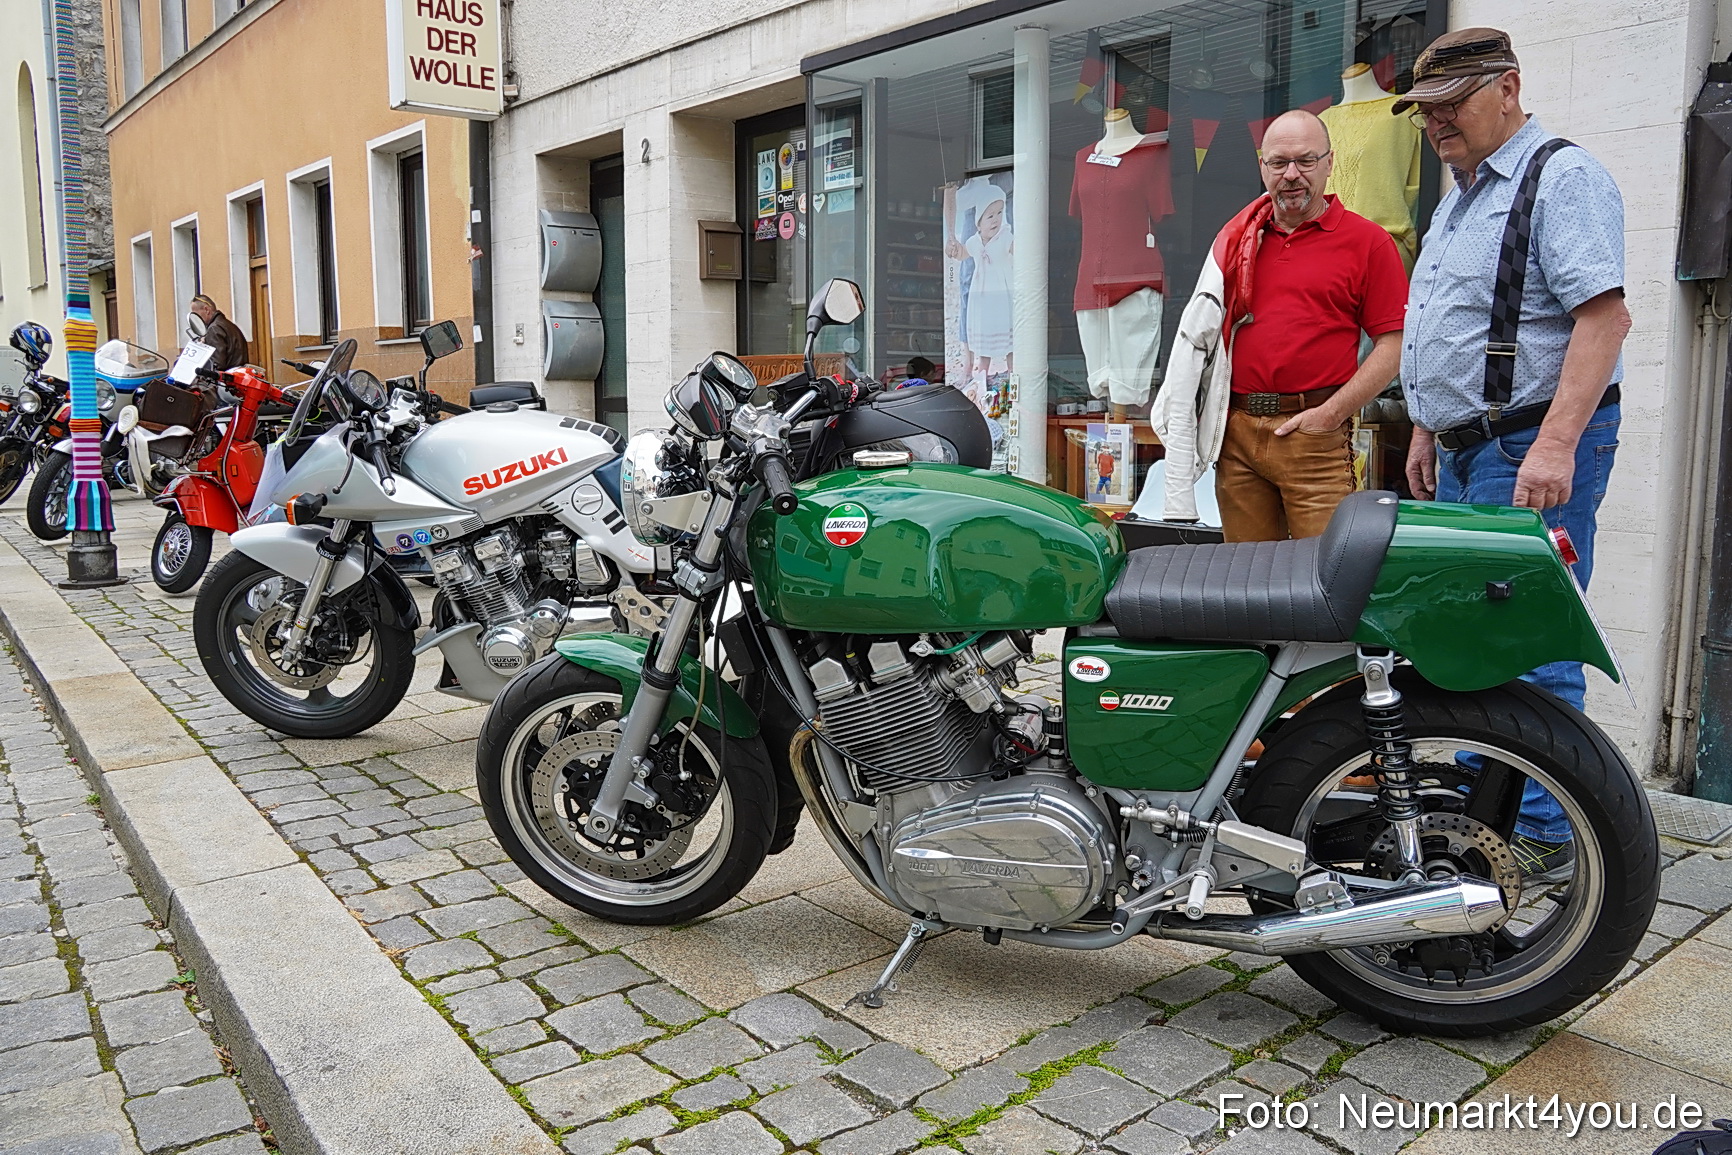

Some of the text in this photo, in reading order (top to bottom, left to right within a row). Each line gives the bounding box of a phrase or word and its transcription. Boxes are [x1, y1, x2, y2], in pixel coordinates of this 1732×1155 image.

[417, 0, 484, 27] HAUS
[427, 27, 477, 57] DER
[409, 55, 495, 91] WOLLE
[641, 137, 650, 165] 2
[778, 191, 794, 209] Opal
[463, 447, 569, 496] SUZUKI
[825, 520, 866, 529] LAVERDA
[1120, 694, 1174, 710] 1000
[961, 861, 1021, 879] LAVERDA
